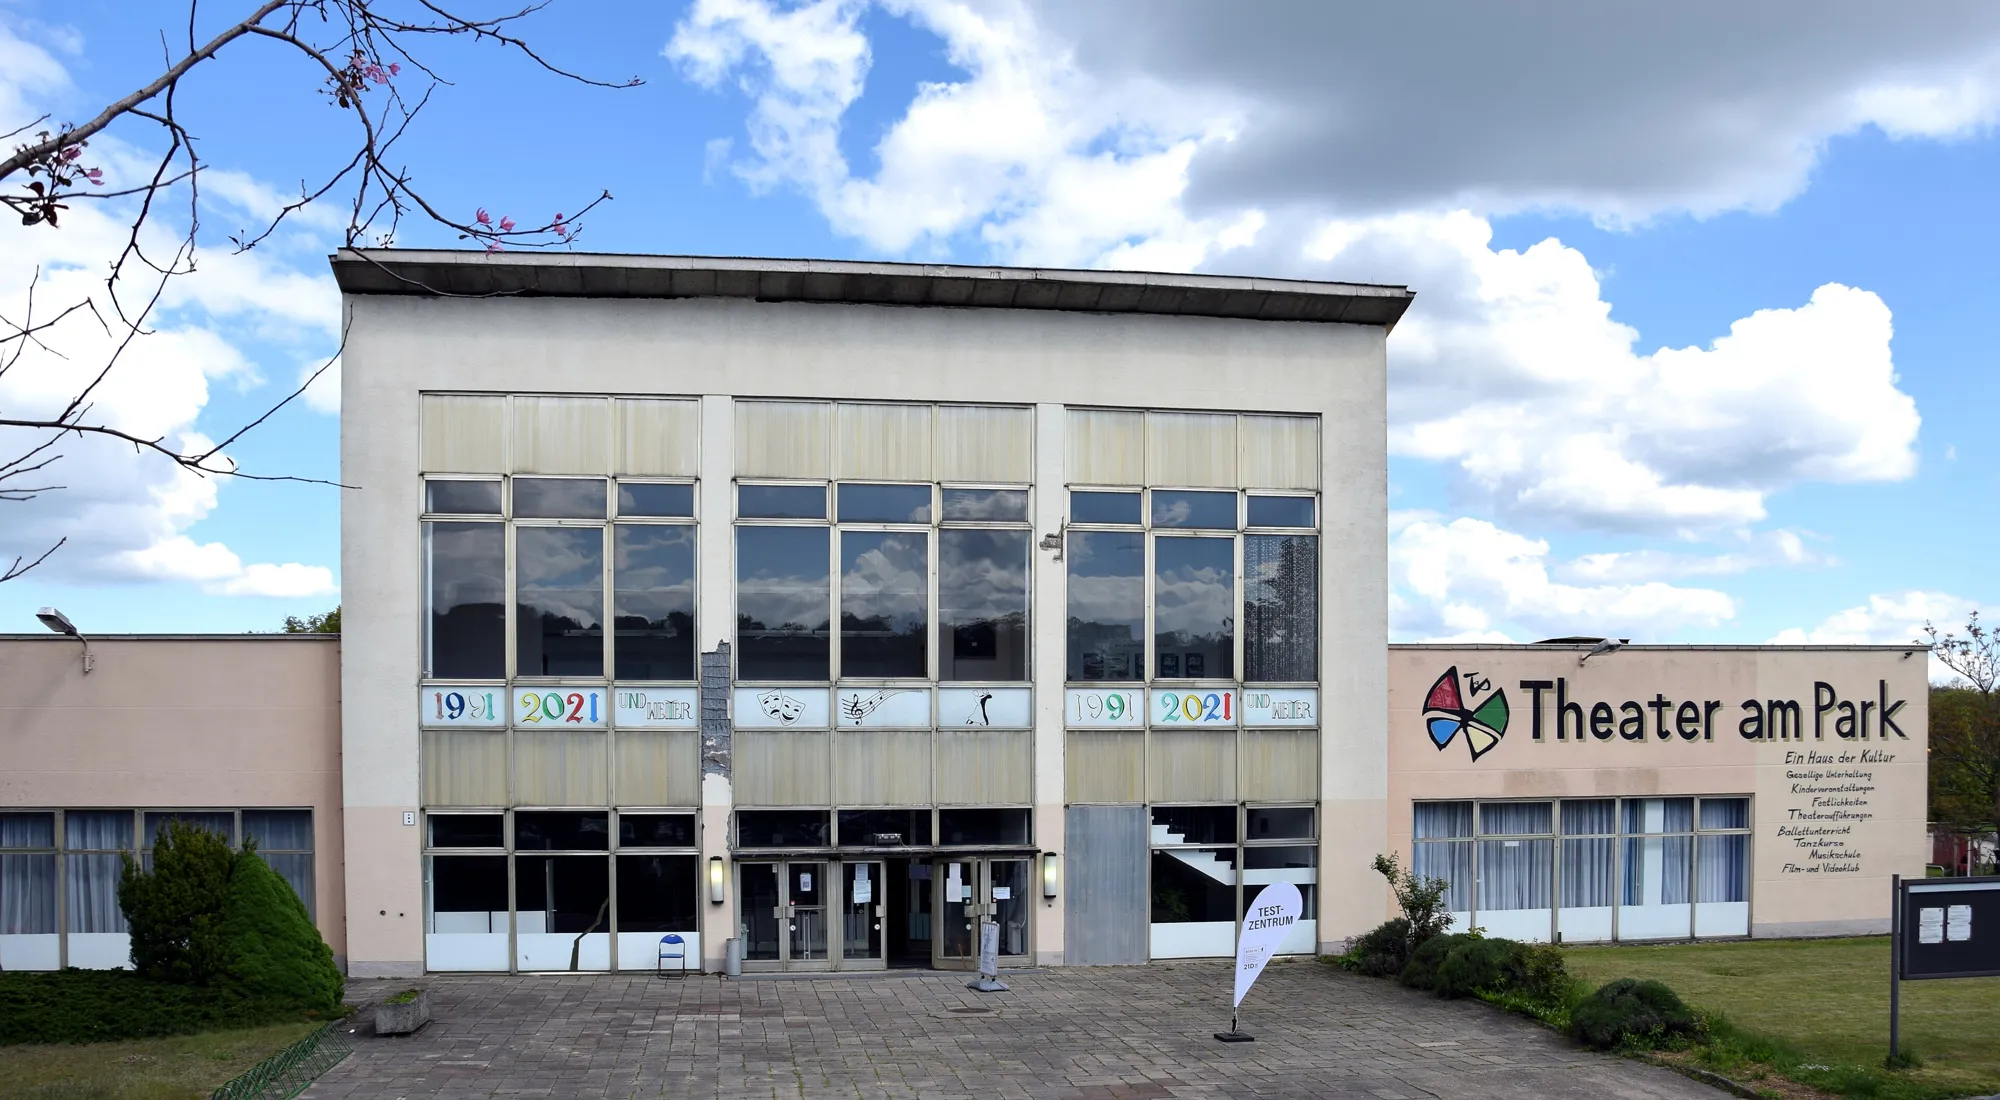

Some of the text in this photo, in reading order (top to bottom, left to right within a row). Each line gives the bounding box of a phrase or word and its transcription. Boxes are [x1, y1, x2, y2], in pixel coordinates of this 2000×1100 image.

[435, 692, 495, 720] 1991
[619, 692, 647, 709] UND
[1076, 693, 1134, 721] 1991
[1161, 692, 1232, 722] 2021
[1246, 693, 1271, 709] UND
[520, 692, 599, 724] 2021
[1520, 678, 1907, 740] Theater am Park
[1785, 749, 1896, 764] Ein Haus der Kultur
[1786, 770, 1872, 781] Gesellige Unterhaltung
[1791, 783, 1875, 794] Kinderveranstaltungen
[1812, 797, 1868, 807] Festlichkeiten
[1788, 808, 1873, 822] Theateraufführungen
[1777, 826, 1851, 836] Ballettunterricht
[1793, 838, 1844, 847] Tanzkurse
[1808, 849, 1861, 859] Musikschule
[1822, 863, 1860, 872] Videoklub
[1258, 905, 1284, 917] TEST-
[1248, 916, 1294, 930] ZENTRUM
